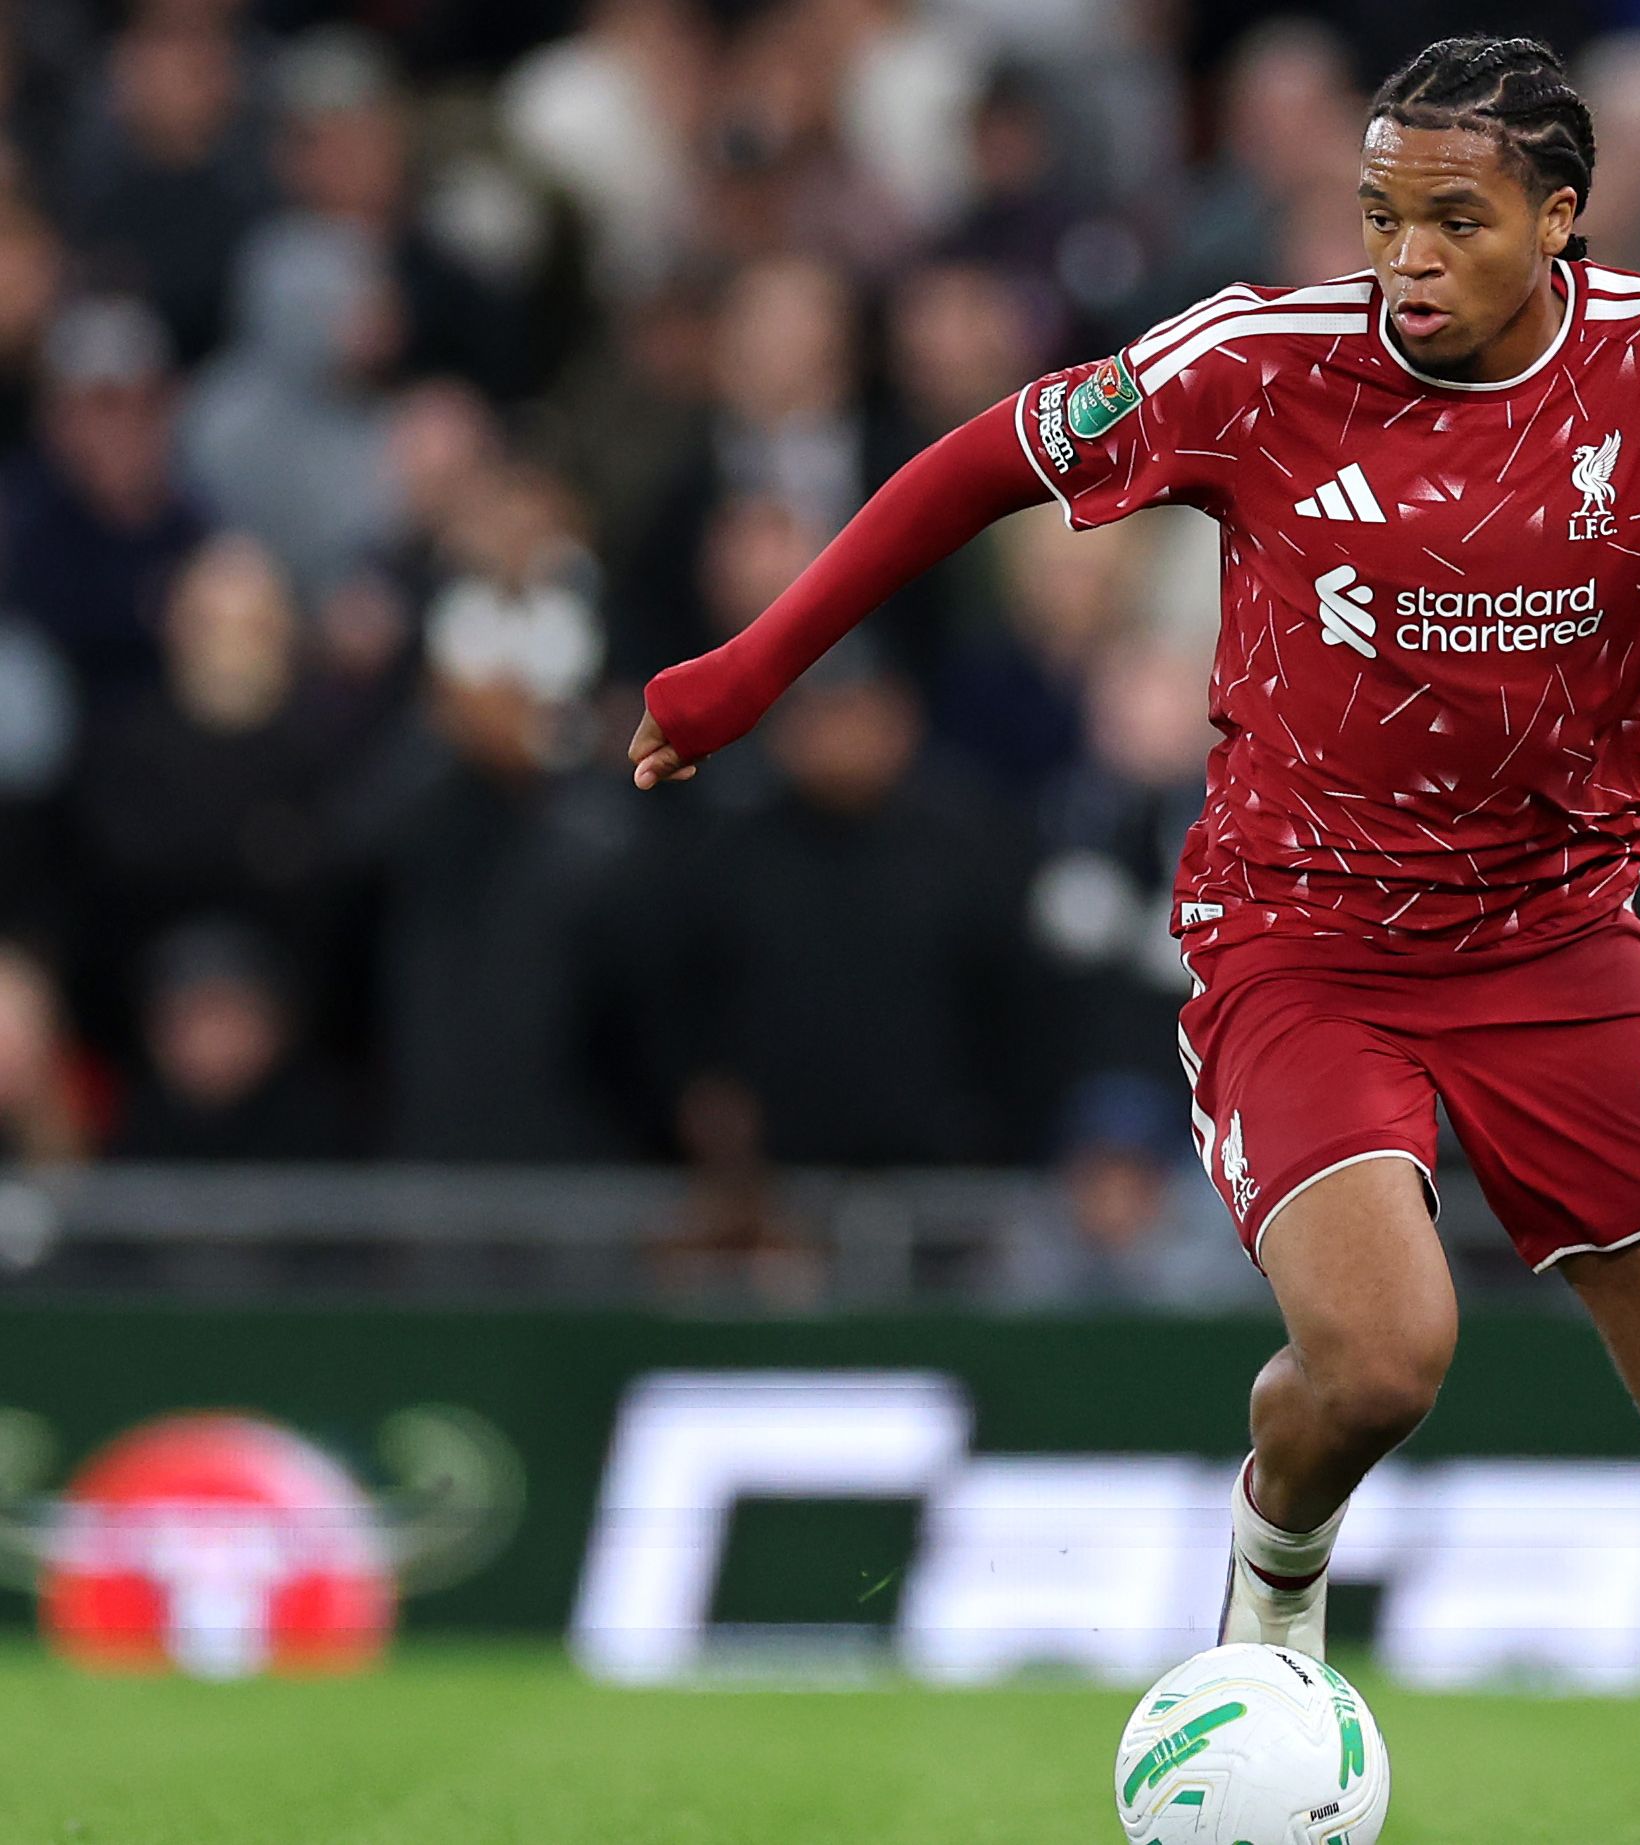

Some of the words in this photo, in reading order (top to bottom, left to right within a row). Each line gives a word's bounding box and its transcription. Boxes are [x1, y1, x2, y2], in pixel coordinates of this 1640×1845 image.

[1039, 386, 1052, 411] for
[1047, 381, 1068, 408] No
[1039, 412, 1069, 474] racism
[1050, 409, 1074, 460] room
[1568, 516, 1618, 541] L.F.C.
[1396, 578, 1596, 617] standard
[1396, 609, 1604, 653] chartered
[1310, 1801, 1340, 1822] PUMA
